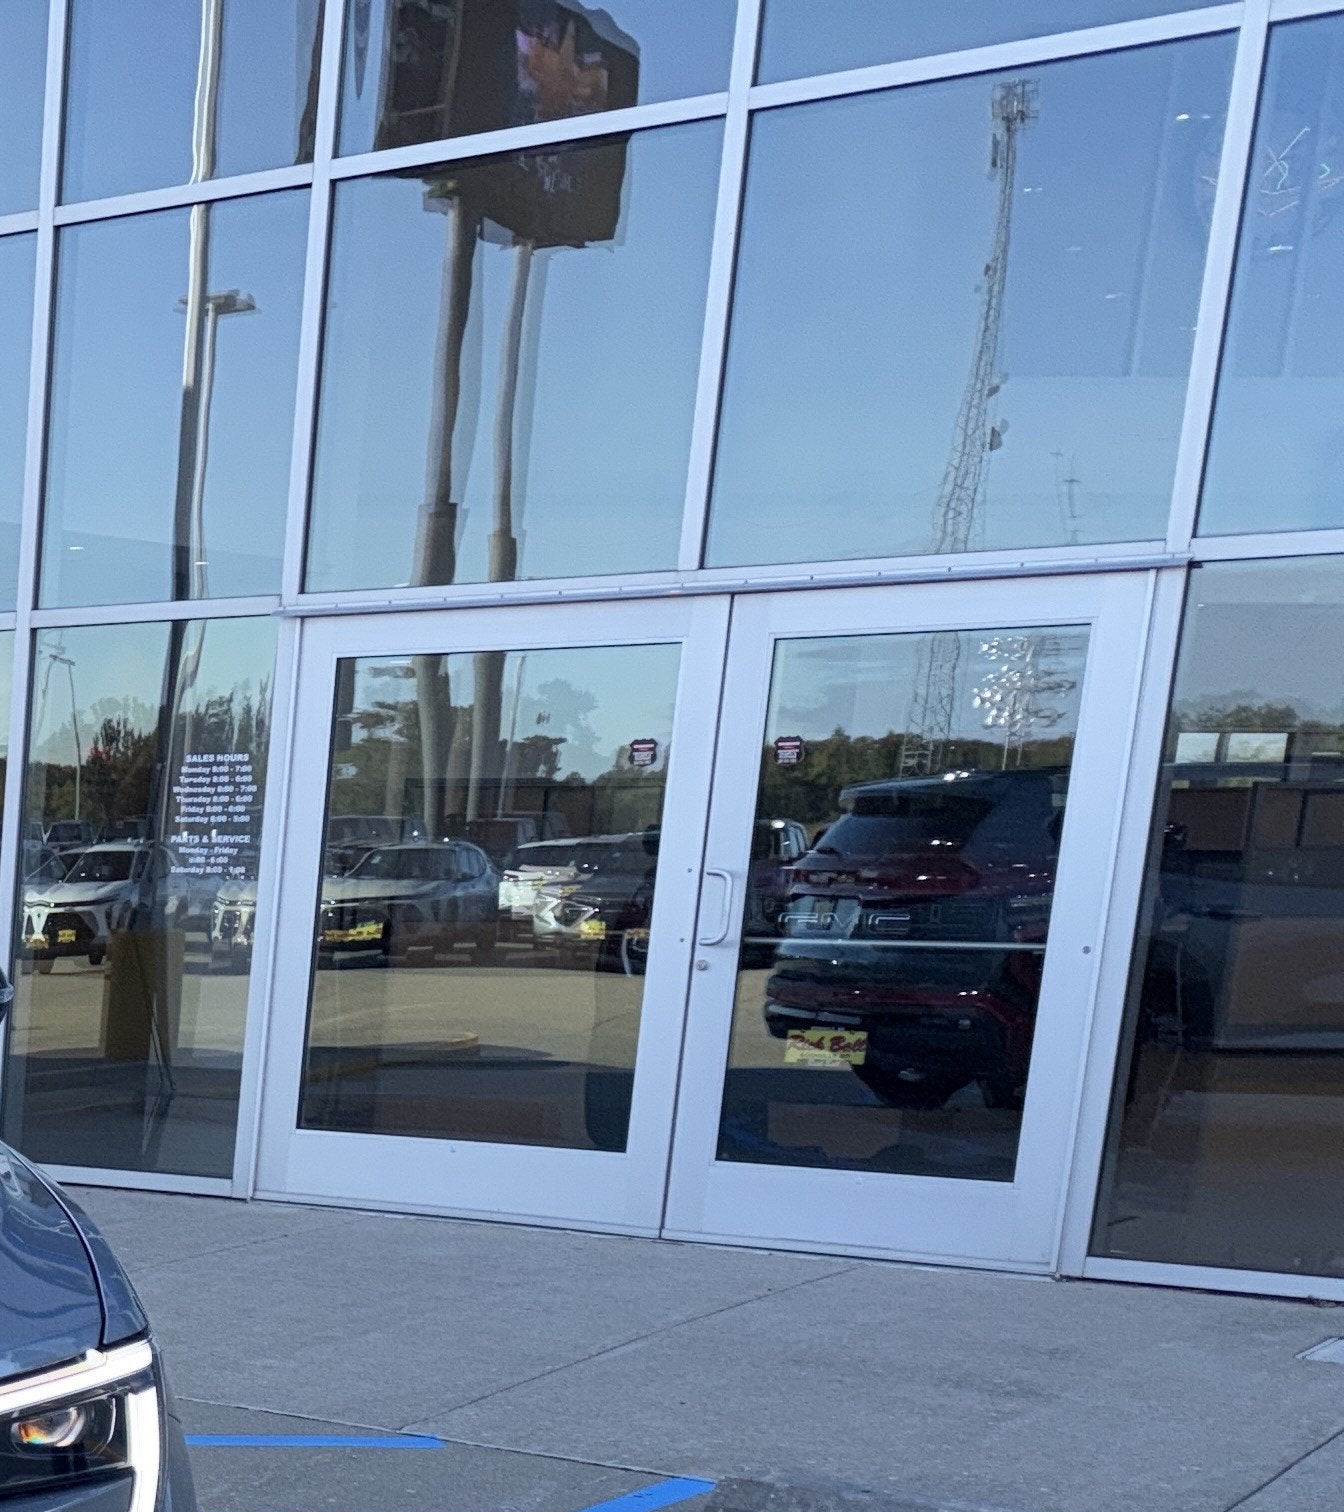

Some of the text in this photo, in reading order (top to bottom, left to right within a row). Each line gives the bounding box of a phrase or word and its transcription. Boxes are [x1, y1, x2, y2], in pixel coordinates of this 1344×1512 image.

[185, 753, 249, 762] SALES HOURS
[181, 765, 211, 774] Monday
[179, 775, 211, 784] Tuesday
[173, 785, 216, 794] Wednesday
[176, 795, 211, 804] Thursday
[181, 805, 204, 814] Friday
[175, 815, 209, 824] Saturday
[171, 835, 251, 843] PARTS & SERVICE
[179, 847, 208, 855] Monday
[214, 847, 238, 855] Friday
[171, 866, 204, 874] Saturday
